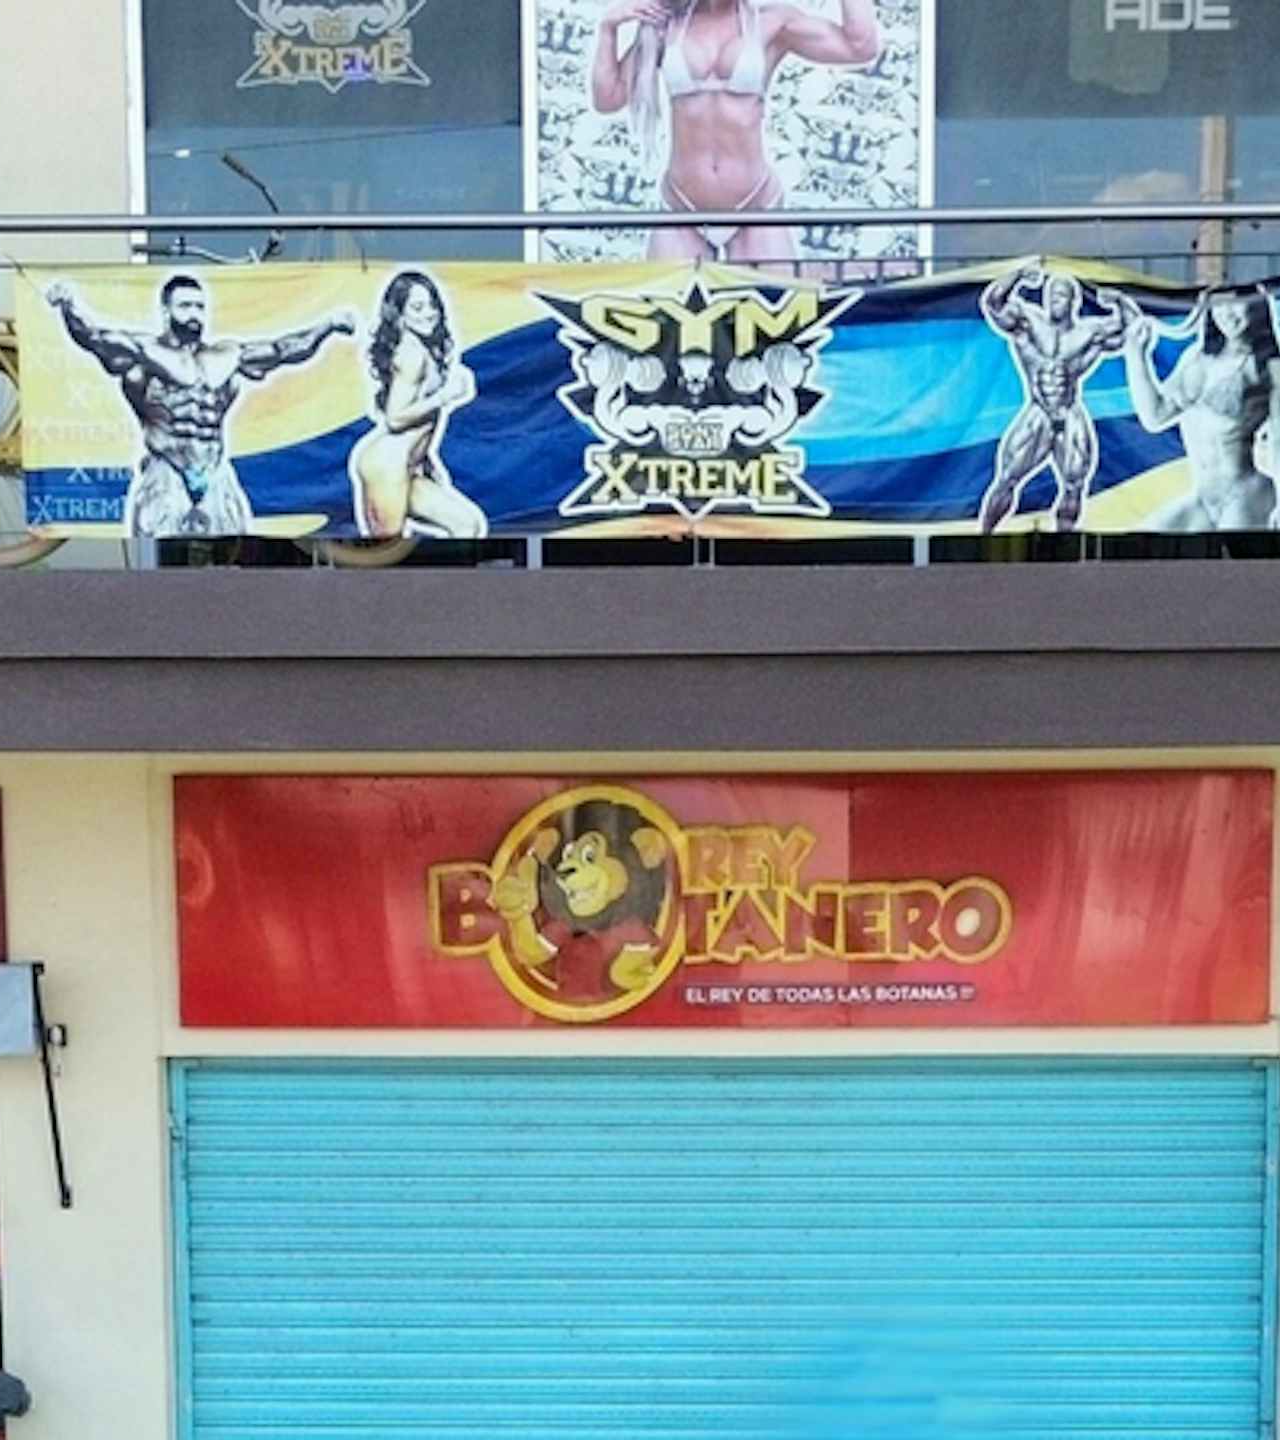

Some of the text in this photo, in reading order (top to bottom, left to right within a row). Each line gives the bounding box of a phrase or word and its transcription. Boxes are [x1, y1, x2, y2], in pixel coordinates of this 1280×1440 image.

[258, 36, 410, 78] XTREME
[582, 289, 819, 354] GYM
[590, 454, 797, 502] XTREME
[33, 496, 123, 524] XTREM
[682, 824, 815, 890] REY
[686, 988, 709, 1004] EL
[710, 988, 744, 1003] REY
[747, 988, 771, 1003] DE
[775, 987, 836, 1003] TODAS
[838, 987, 871, 1002] LAS
[875, 985, 957, 1002] BOTANAS
